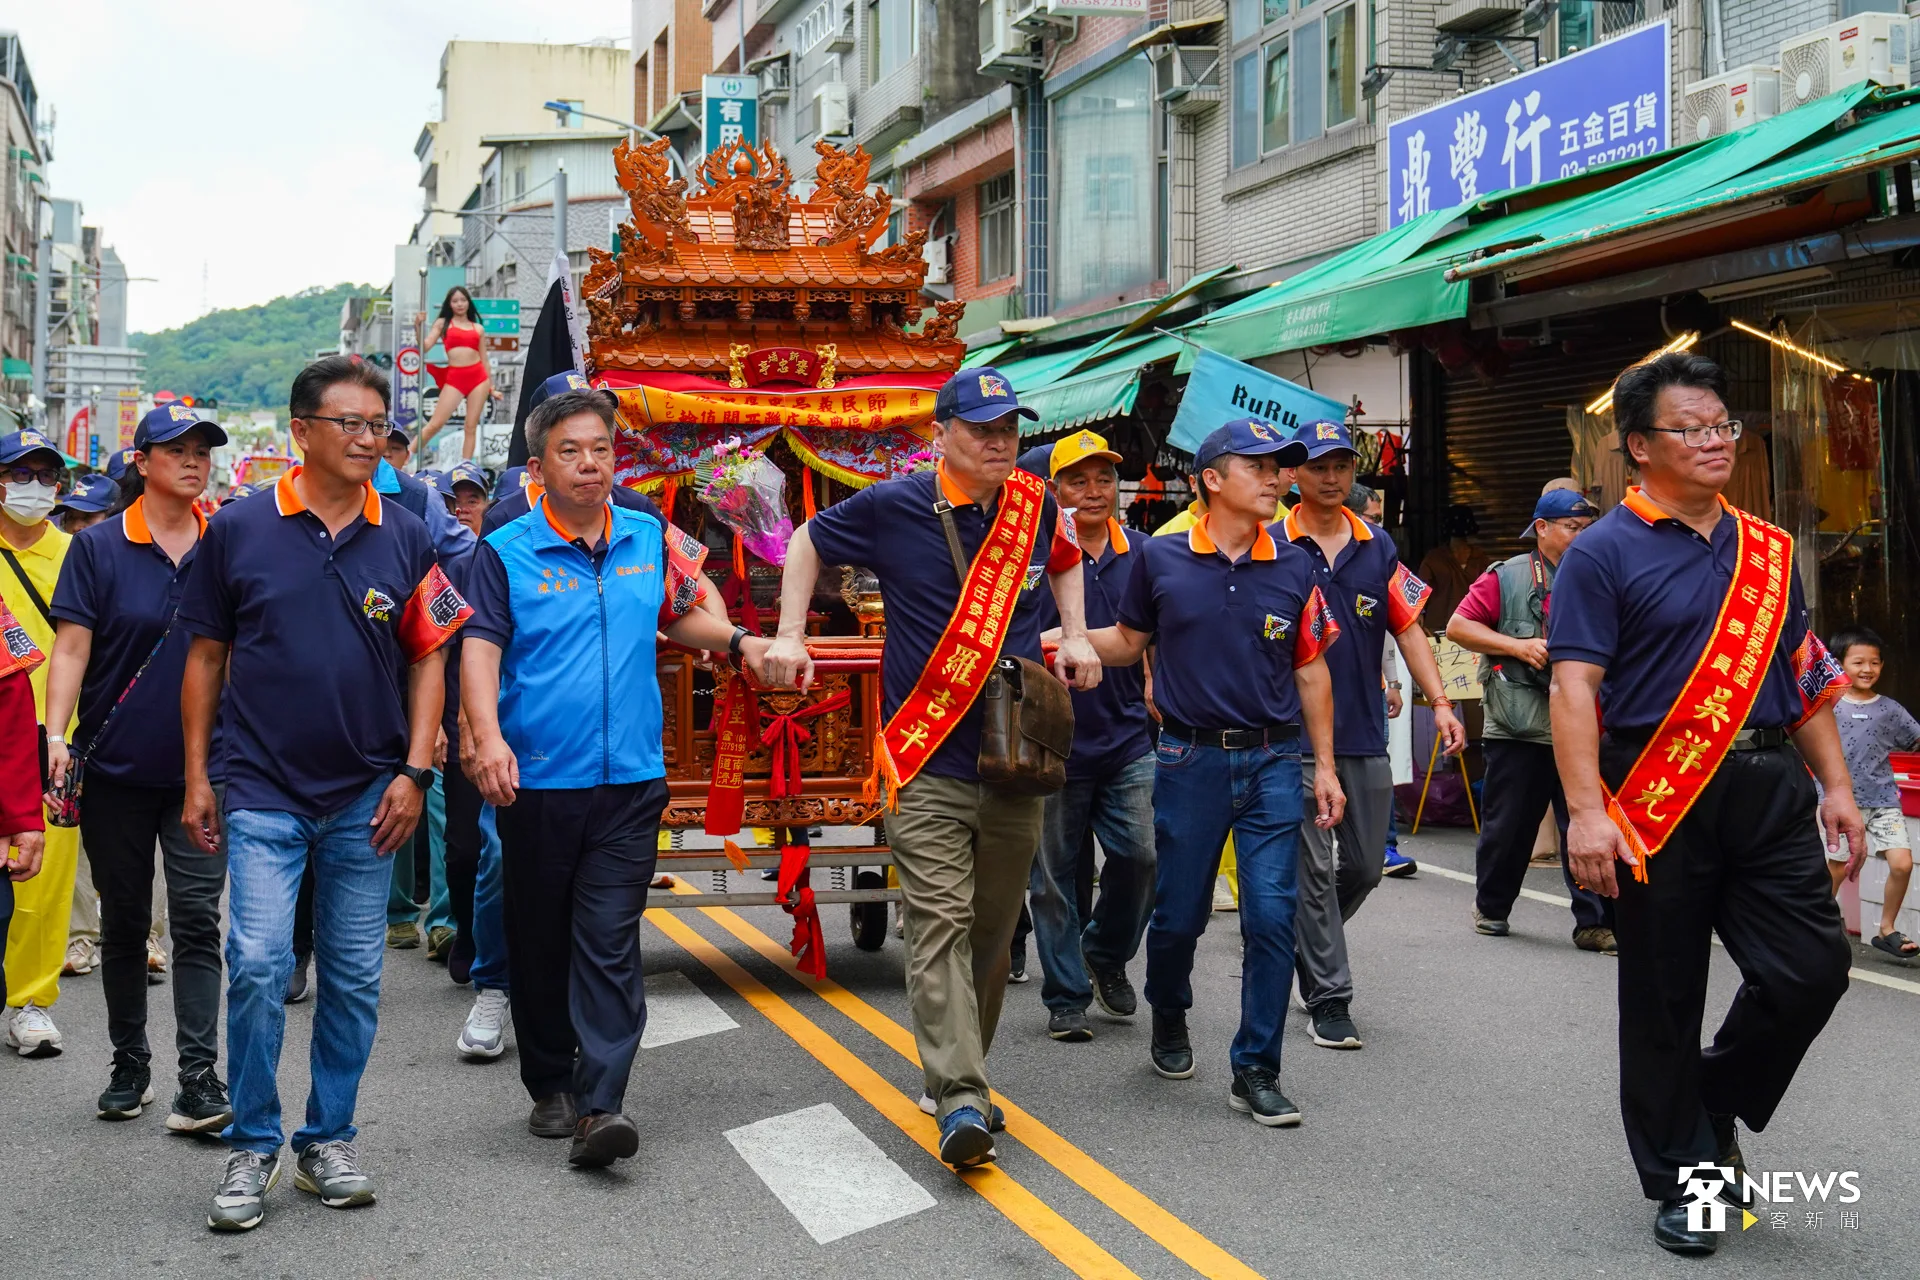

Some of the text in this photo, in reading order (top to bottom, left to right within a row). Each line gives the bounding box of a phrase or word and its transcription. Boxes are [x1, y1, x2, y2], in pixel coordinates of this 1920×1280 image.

[1398, 89, 1551, 223] 鼎豐行
[1559, 92, 1658, 157] 五金百貨
[403, 355, 420, 367] 50
[1231, 383, 1300, 430] RuRu
[1007, 469, 1044, 497] 2025
[1711, 525, 1766, 677] 副主任委員
[899, 643, 982, 755] 羅吉平
[1633, 685, 1734, 824] 吳祥光
